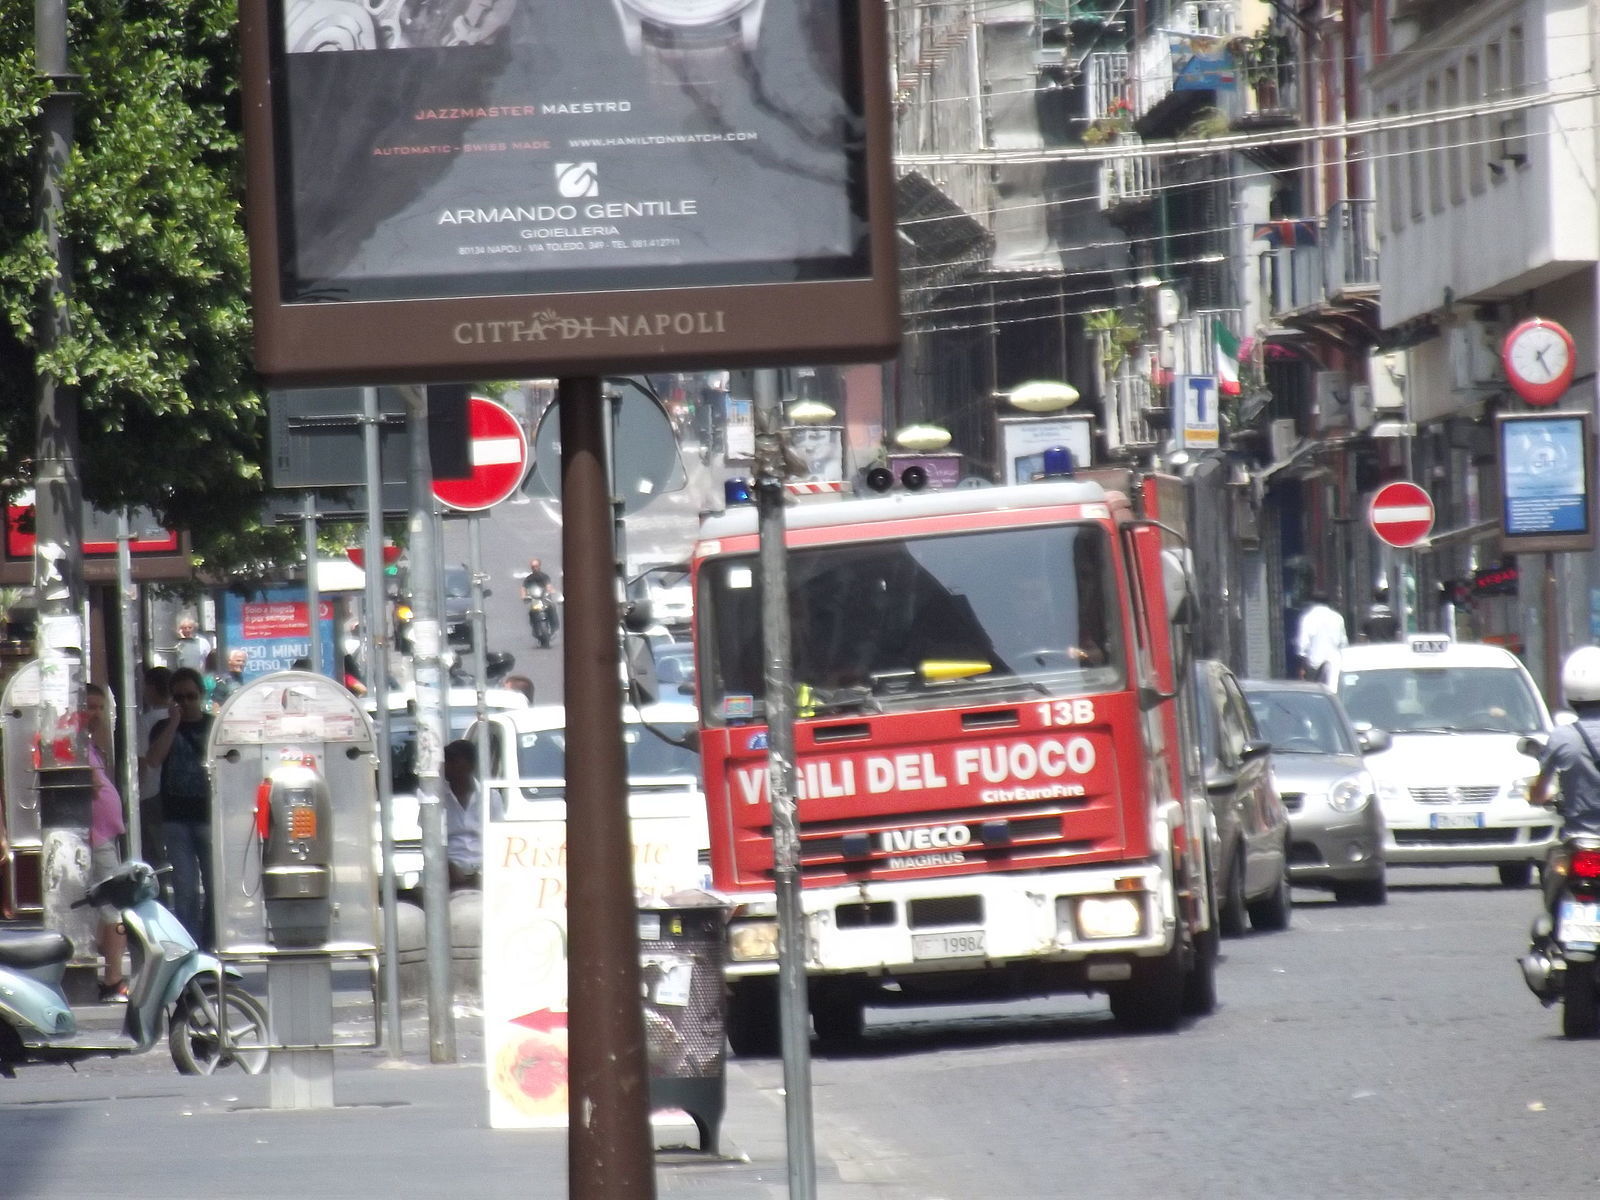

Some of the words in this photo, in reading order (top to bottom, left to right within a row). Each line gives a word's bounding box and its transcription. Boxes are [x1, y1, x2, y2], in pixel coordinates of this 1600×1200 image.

[414, 105, 535, 120] JAZZMASTER
[542, 101, 632, 115] MAESTRO
[373, 144, 451, 155] AUTOMATIC
[463, 143, 506, 153] SWISS
[511, 140, 551, 150] MADE
[569, 132, 758, 148] WWW.HAMILTONWATCH.COM
[438, 205, 578, 224] ARMANDO
[585, 200, 698, 219] GENTILE
[520, 226, 620, 239] GIOIELLERIA
[486, 244, 522, 254] NAPOLI
[528, 243, 545, 252] VIA
[560, 317, 595, 340] DI
[608, 311, 726, 338] NAPOLI
[1189, 378, 1213, 422] T
[1037, 699, 1096, 727] 13B
[866, 752, 948, 795] DEL
[955, 736, 1097, 786] FUOCO
[980, 783, 1086, 804] CityEuroFire
[882, 824, 972, 853] IVECO
[889, 851, 966, 869] MAGIRUS
